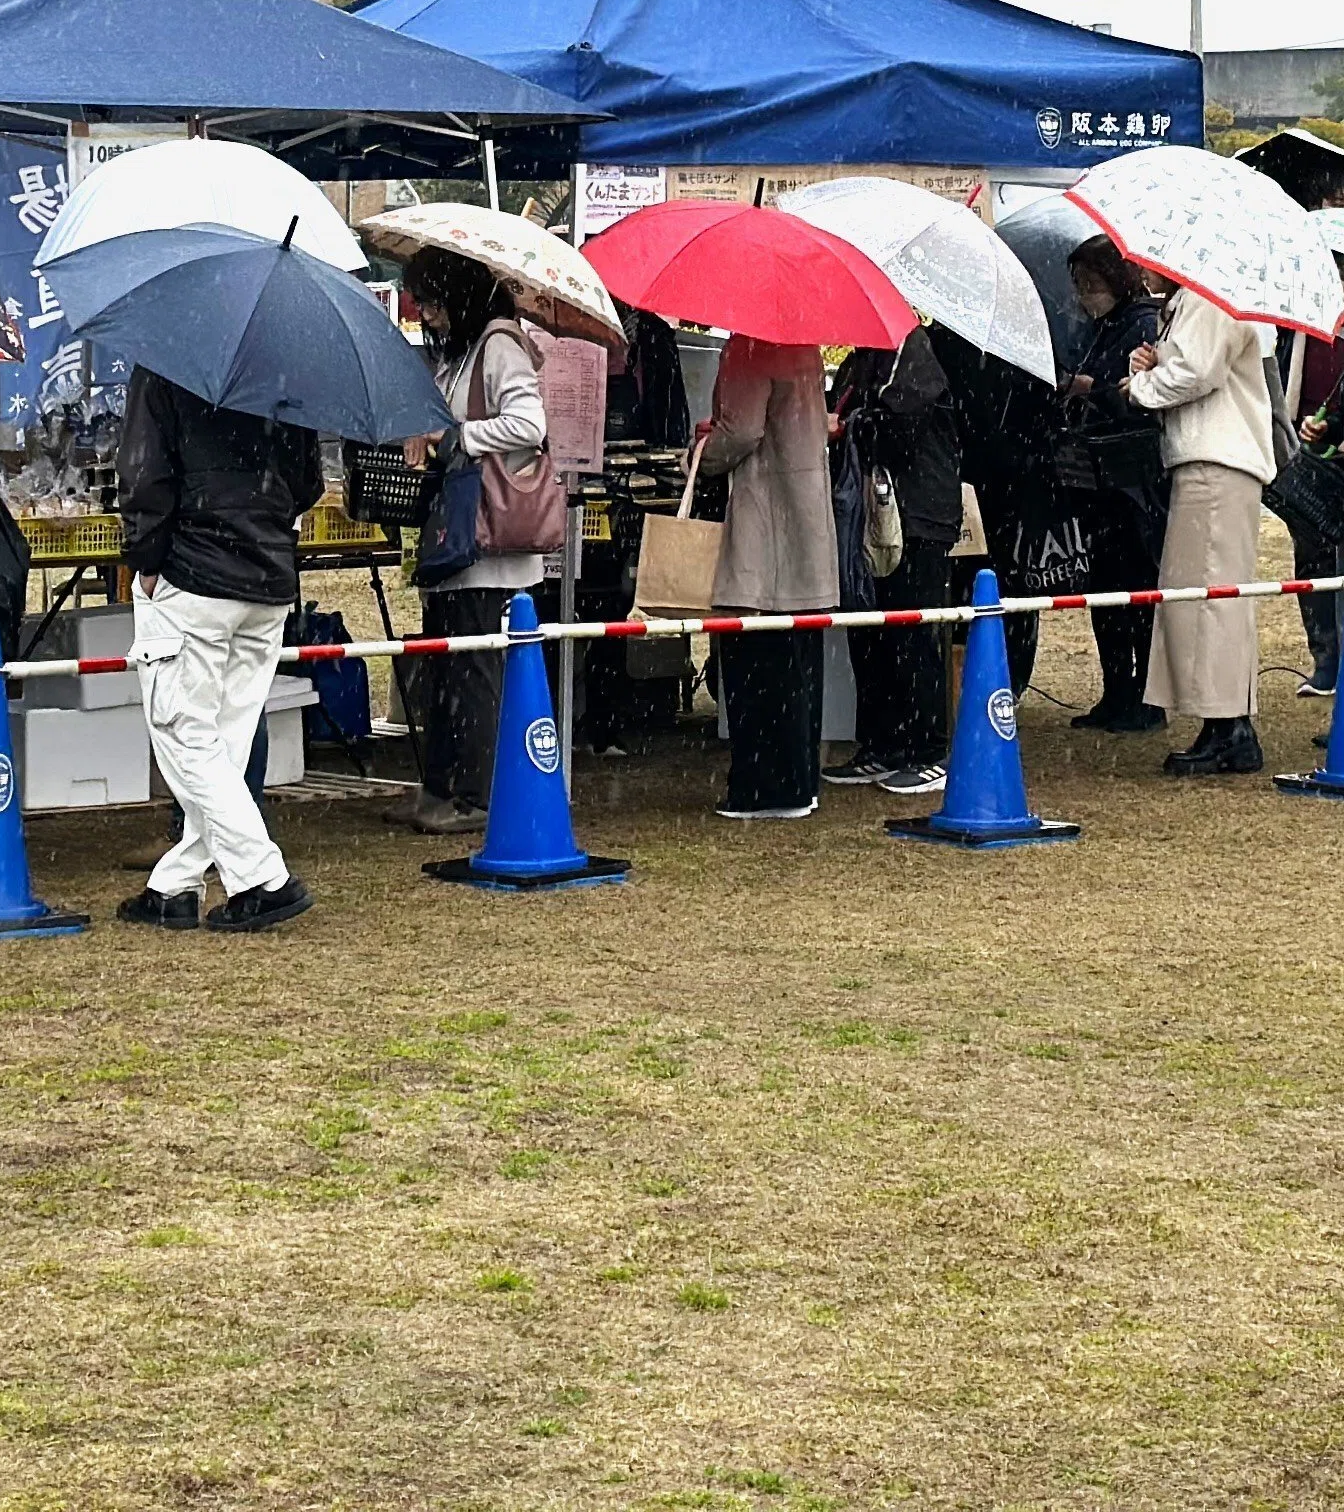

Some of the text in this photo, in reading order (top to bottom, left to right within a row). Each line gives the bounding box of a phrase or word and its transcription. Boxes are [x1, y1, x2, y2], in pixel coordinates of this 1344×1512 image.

[1071, 112, 1171, 137] 阪本鶏卵
[585, 181, 662, 203] くんたまサンド
